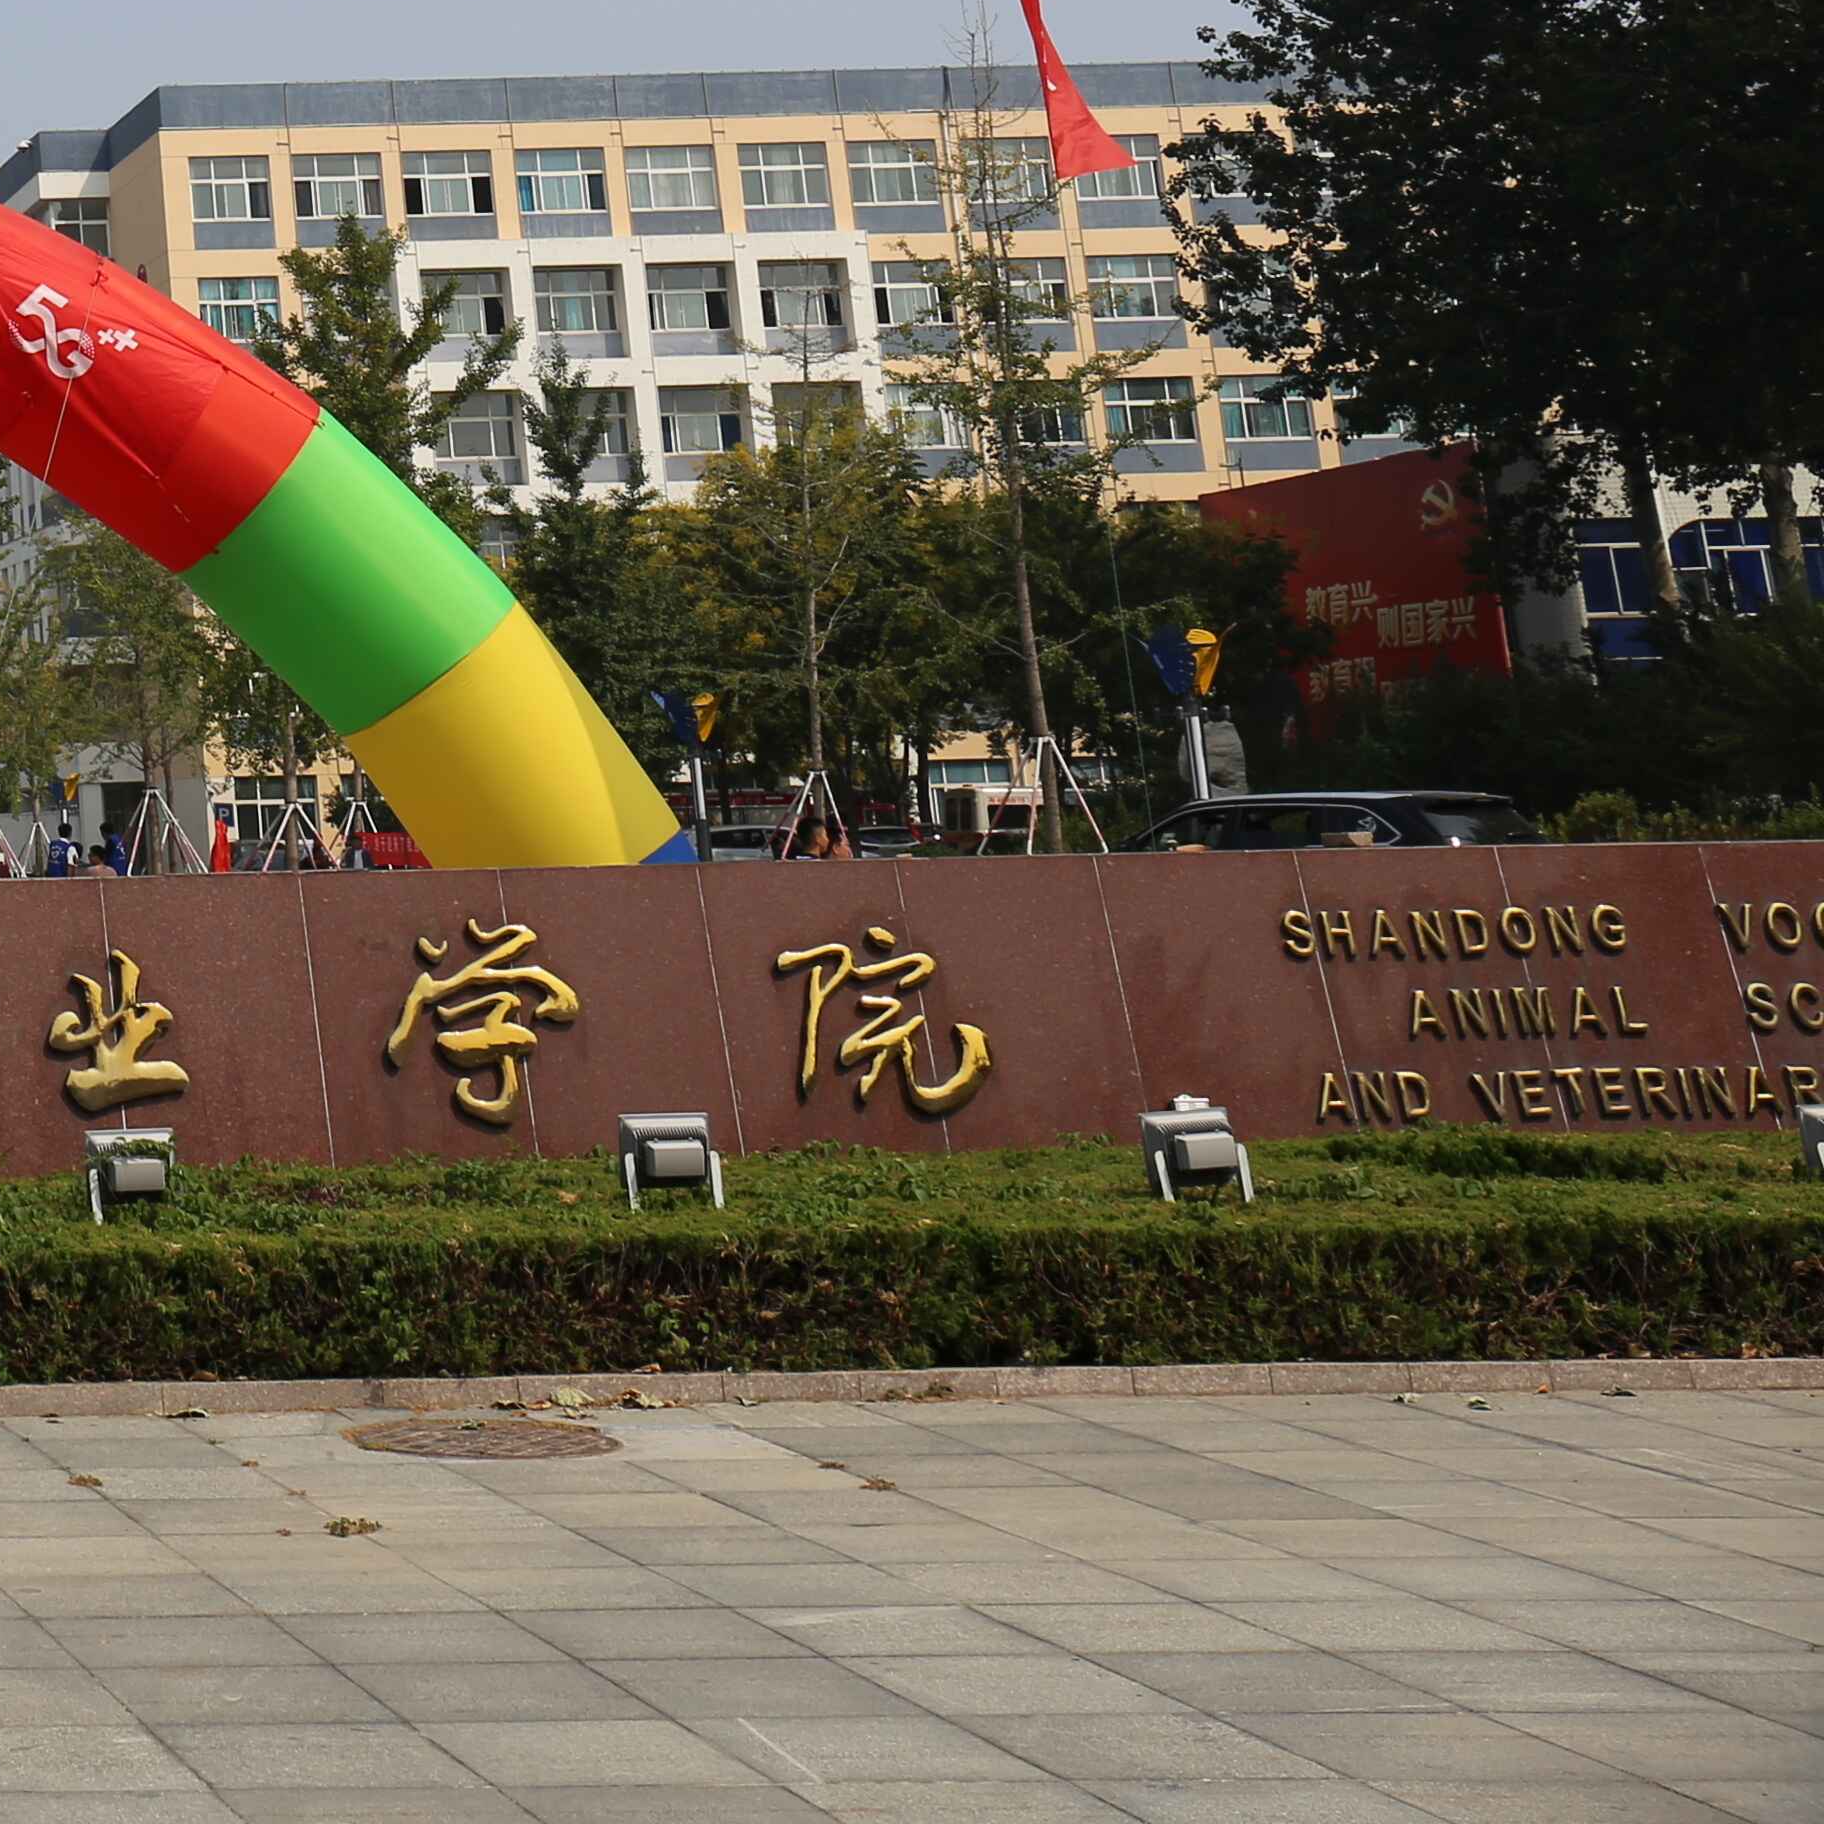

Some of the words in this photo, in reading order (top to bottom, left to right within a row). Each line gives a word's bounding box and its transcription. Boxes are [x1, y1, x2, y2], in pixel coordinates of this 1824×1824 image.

[1305, 580, 1378, 625] 教育兴
[1376, 595, 1477, 649] 则国家兴
[1280, 902, 1629, 959] SHANDONG
[1716, 901, 1824, 949] VO
[1409, 985, 1650, 1039] ANIMAL
[1316, 1071, 1432, 1123] AND
